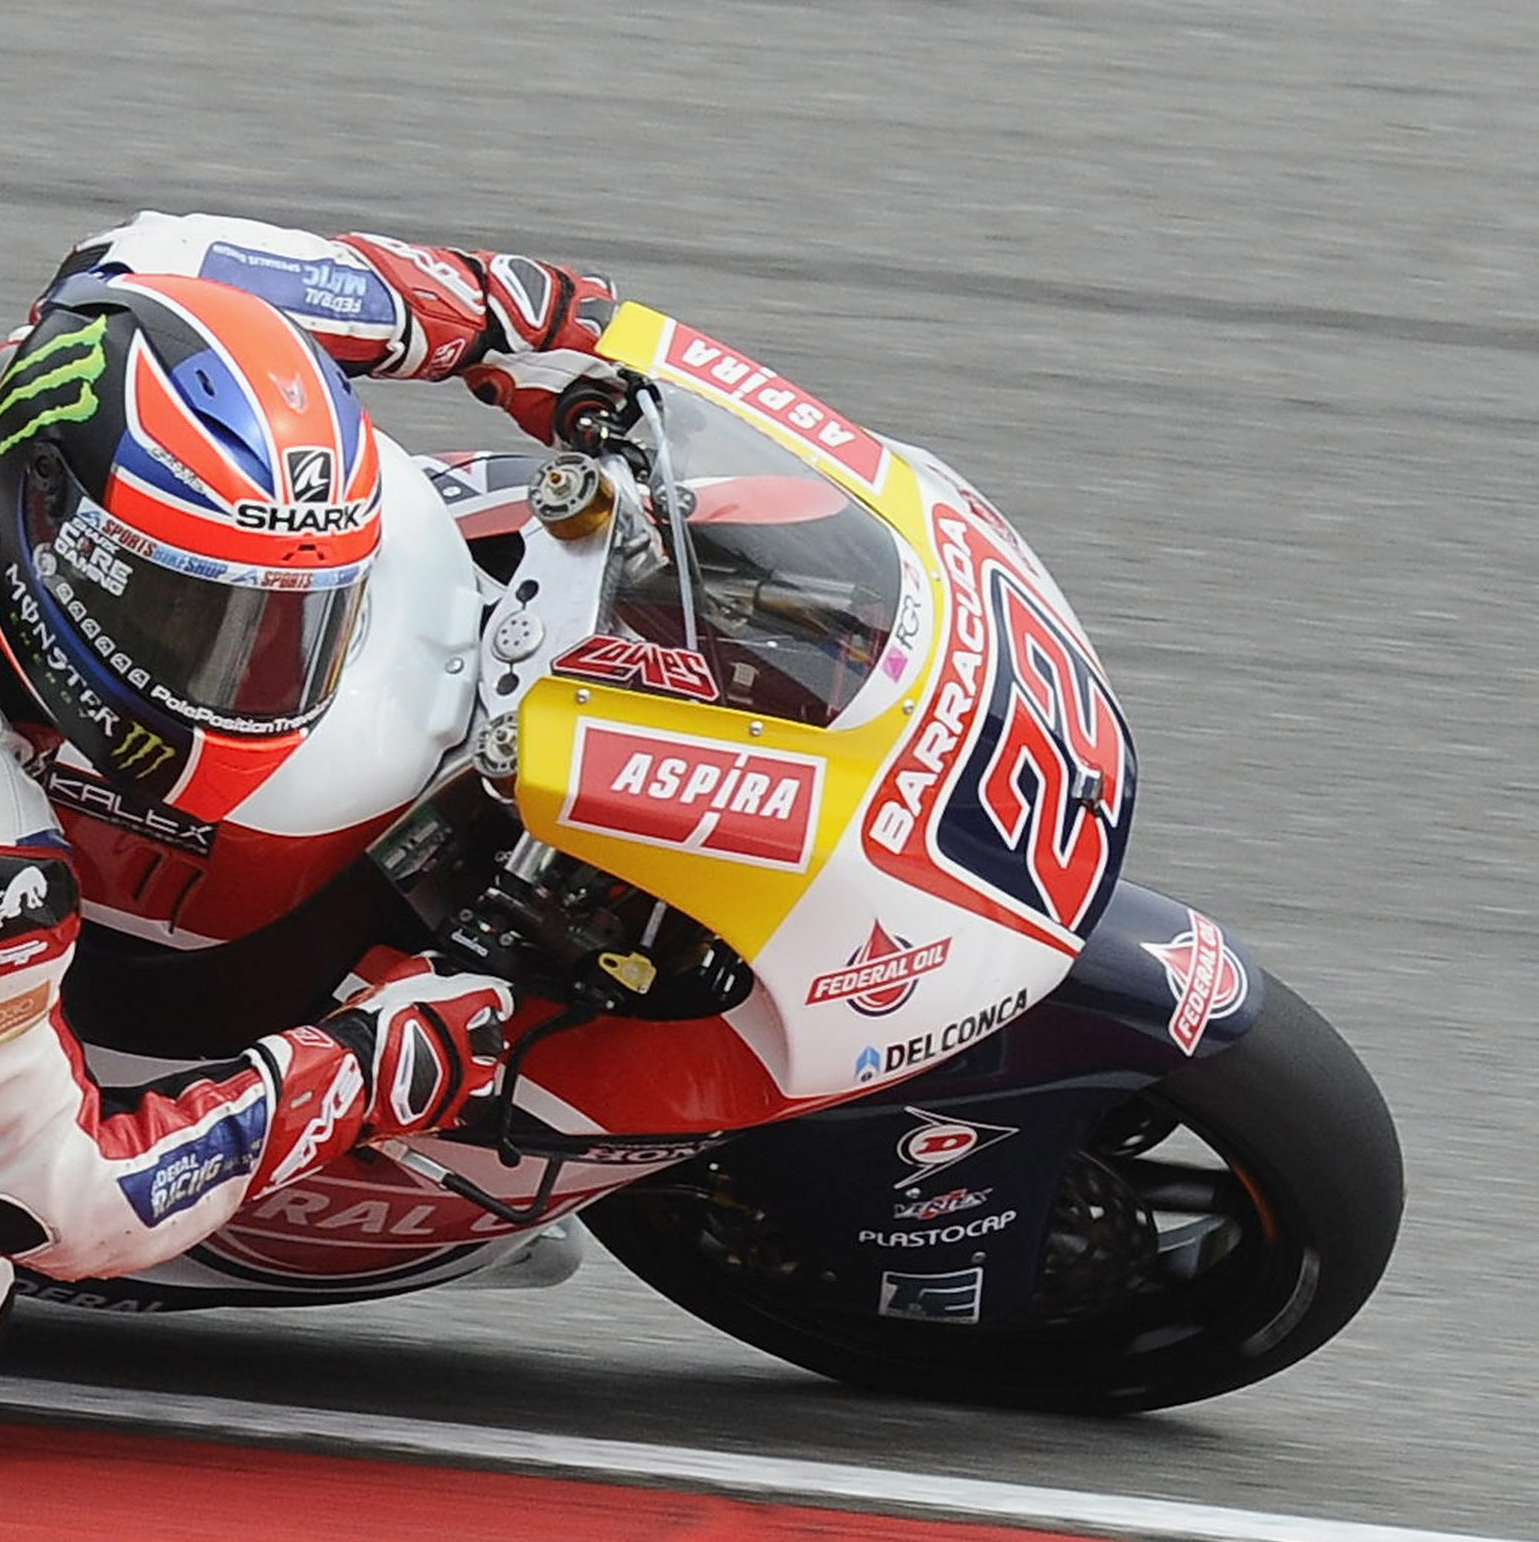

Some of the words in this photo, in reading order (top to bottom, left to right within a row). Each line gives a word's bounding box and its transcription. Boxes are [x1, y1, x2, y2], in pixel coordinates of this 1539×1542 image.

[681, 338, 857, 449] ASPIRA
[236, 503, 361, 532] SHARK
[870, 516, 983, 854] BARRACUDA
[611, 753, 802, 822] ASPIRA
[978, 578, 1128, 935] 22
[49, 771, 213, 845] KALEX
[814, 957, 909, 999] FEDERAL
[913, 944, 945, 972] OIL
[1177, 947, 1218, 1039] FEDERAL
[885, 1033, 936, 1073] DEL
[941, 987, 1028, 1051] CONCA
[858, 1210, 1017, 1247] PLASTOCAP
